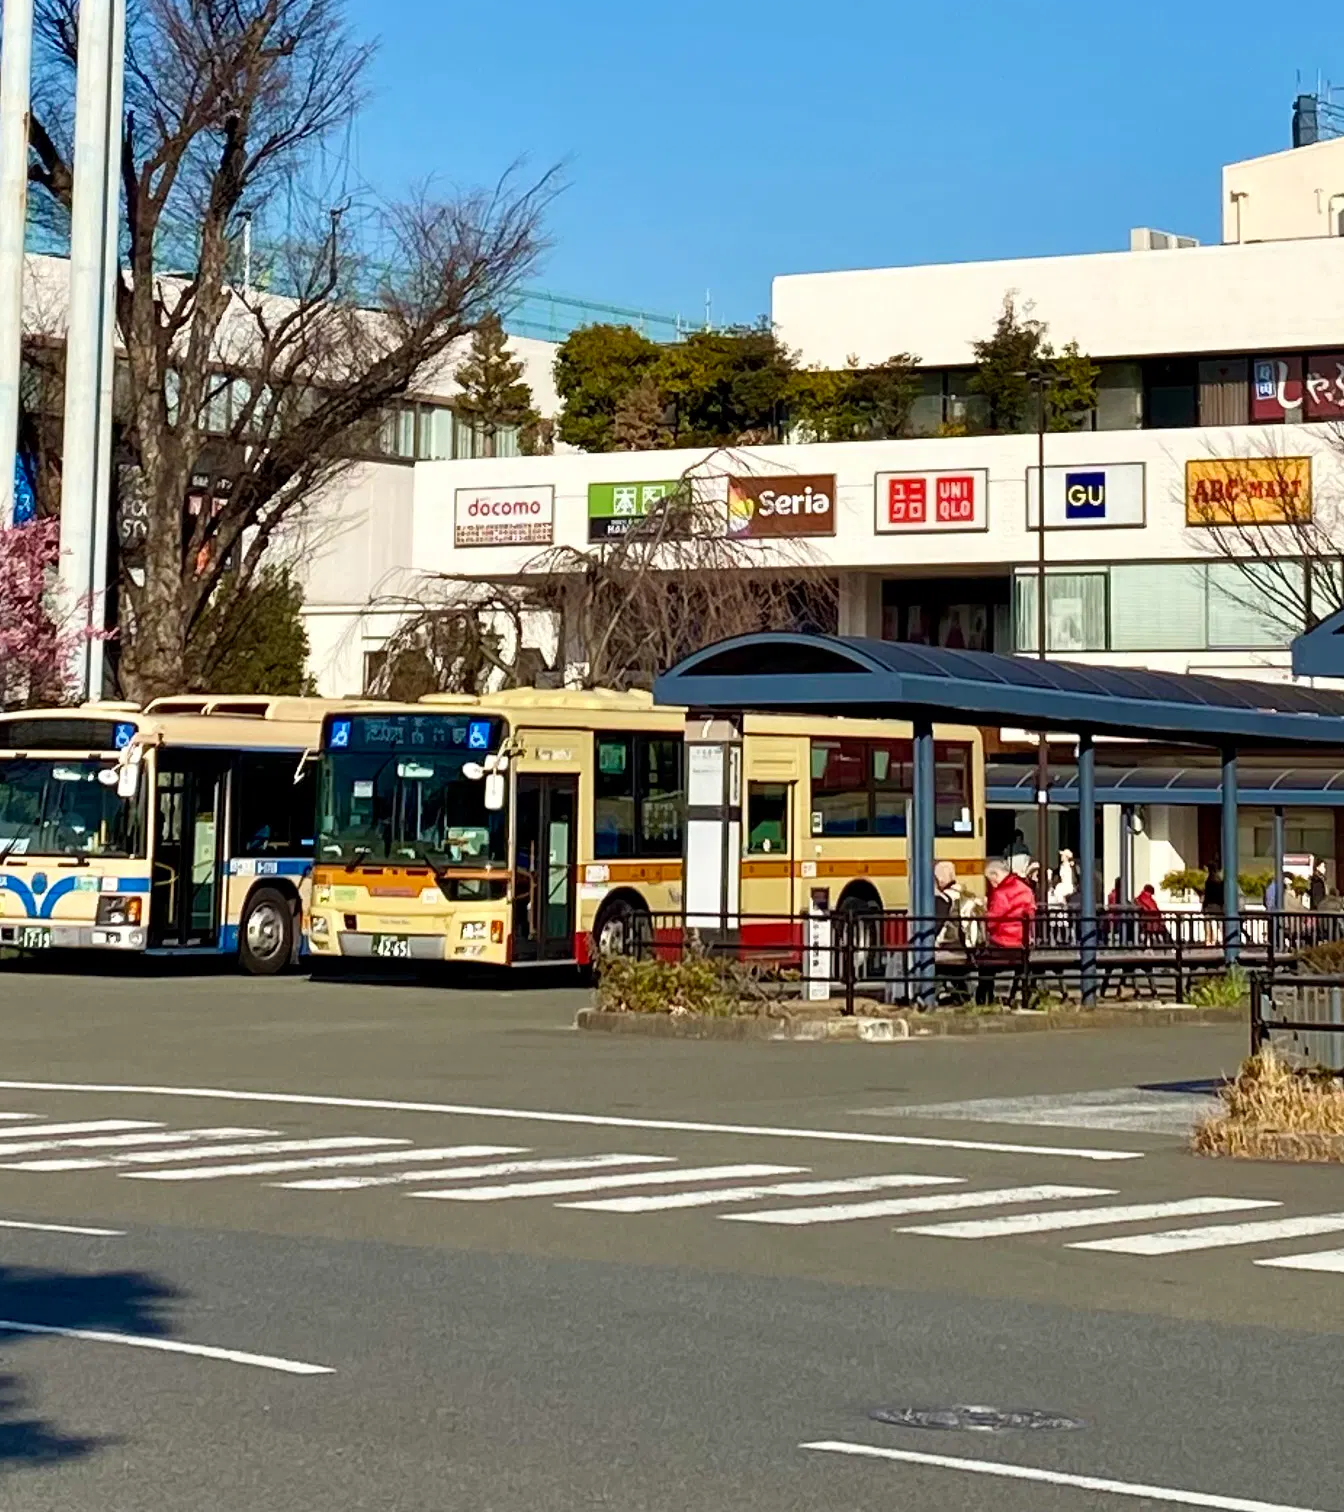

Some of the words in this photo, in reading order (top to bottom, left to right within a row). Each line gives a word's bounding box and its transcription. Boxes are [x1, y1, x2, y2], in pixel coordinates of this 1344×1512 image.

[939, 481, 969, 499] UNI
[1068, 484, 1105, 507] GU
[468, 497, 541, 517] docomo
[758, 490, 831, 517] Seria
[939, 500, 971, 520] QLO
[699, 714, 715, 739] 7
